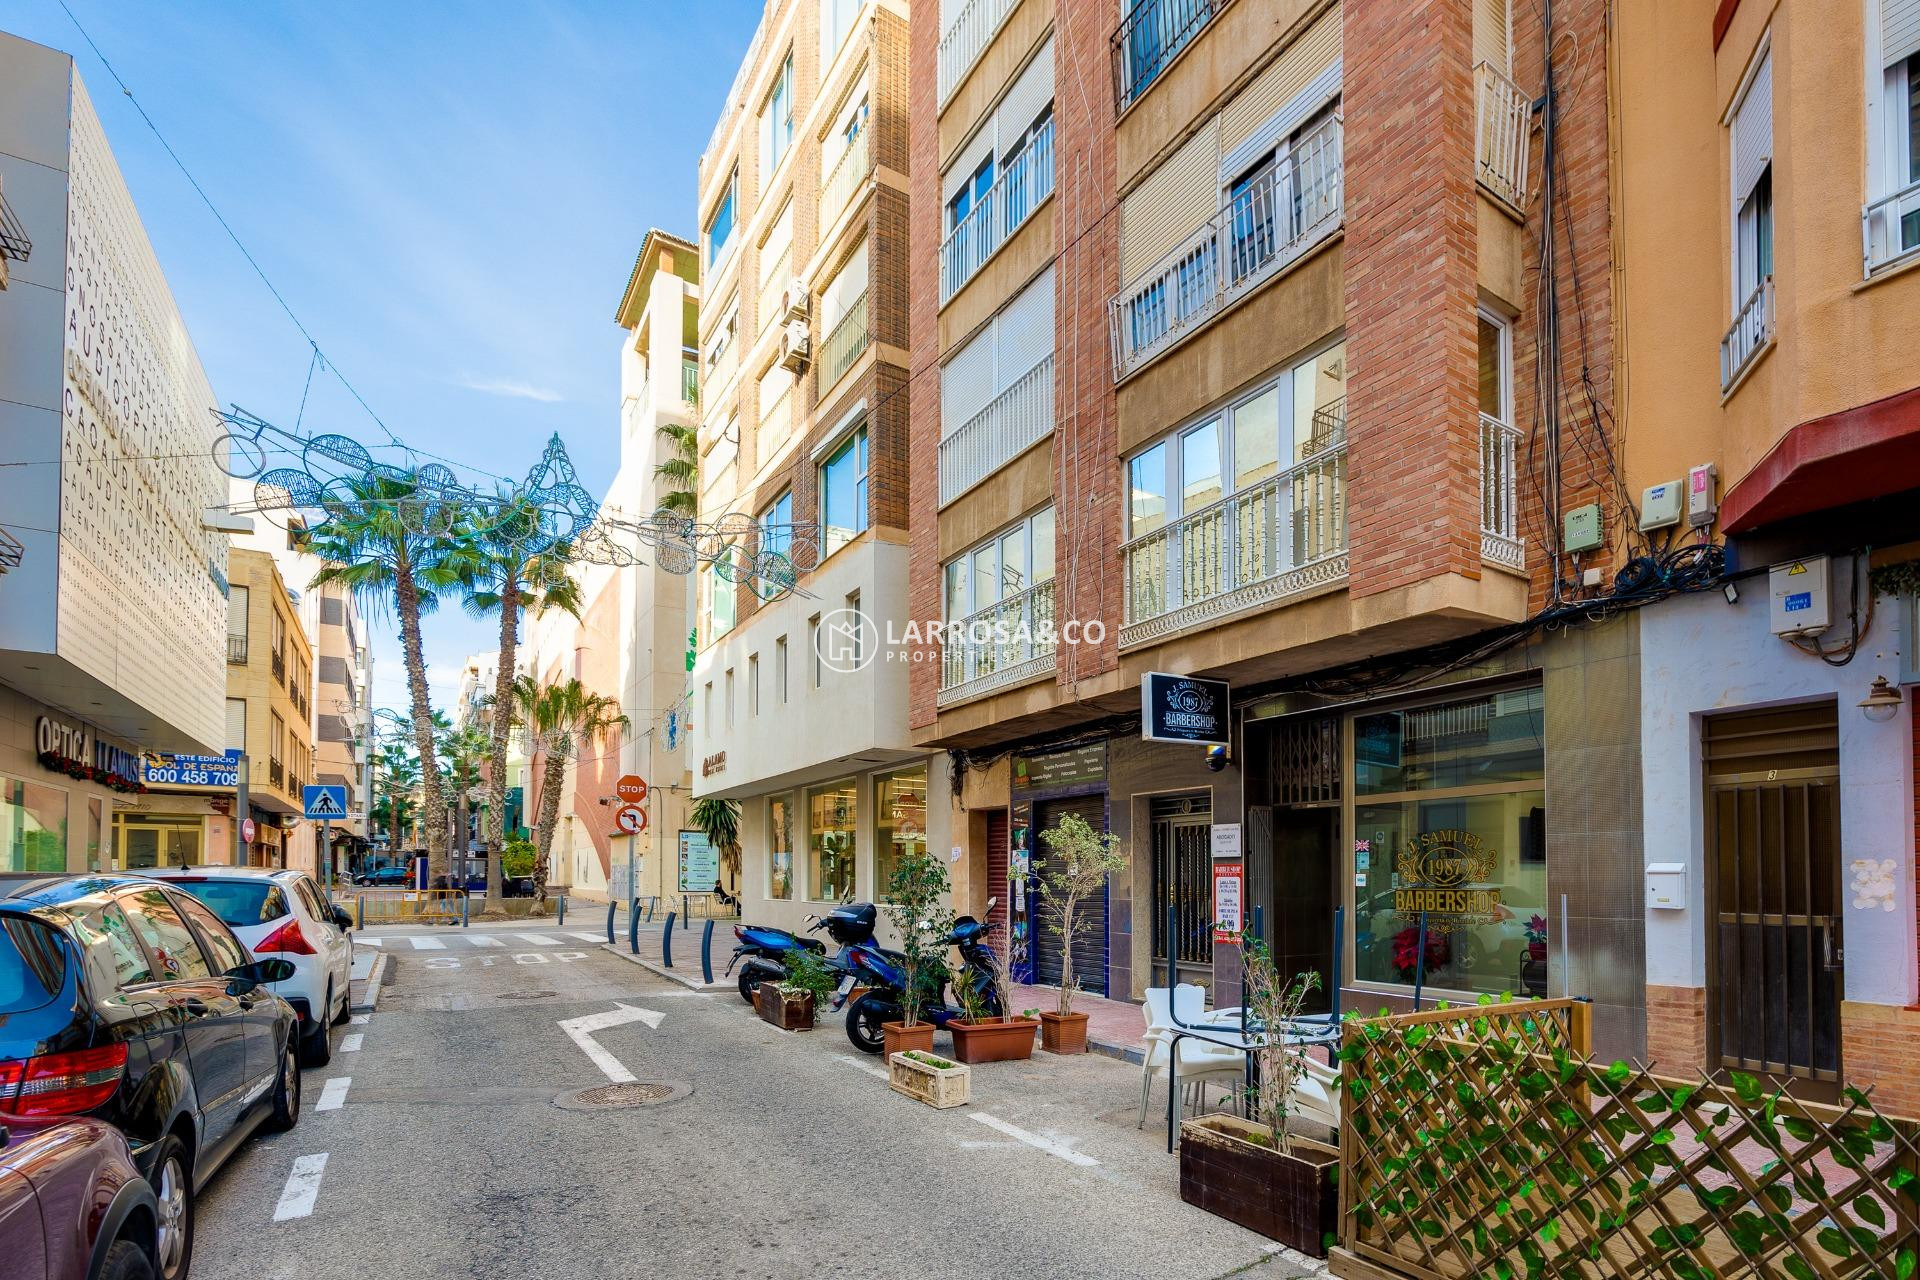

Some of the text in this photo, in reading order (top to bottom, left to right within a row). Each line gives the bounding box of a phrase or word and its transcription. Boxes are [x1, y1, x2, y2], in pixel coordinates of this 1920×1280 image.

[1182, 697, 1199, 707] 1987
[1165, 712, 1215, 728] BARBERSHOP
[198, 756, 235, 764] EDIFICIO
[148, 769, 238, 786] 600 458 709
[1769, 770, 1776, 780] 3
[619, 785, 645, 794] STOP
[1421, 830, 1482, 852] SAMUEL
[1428, 859, 1462, 876] 1987
[1395, 890, 1501, 913] BARBERSHOP
[425, 952, 589, 969] STOP
